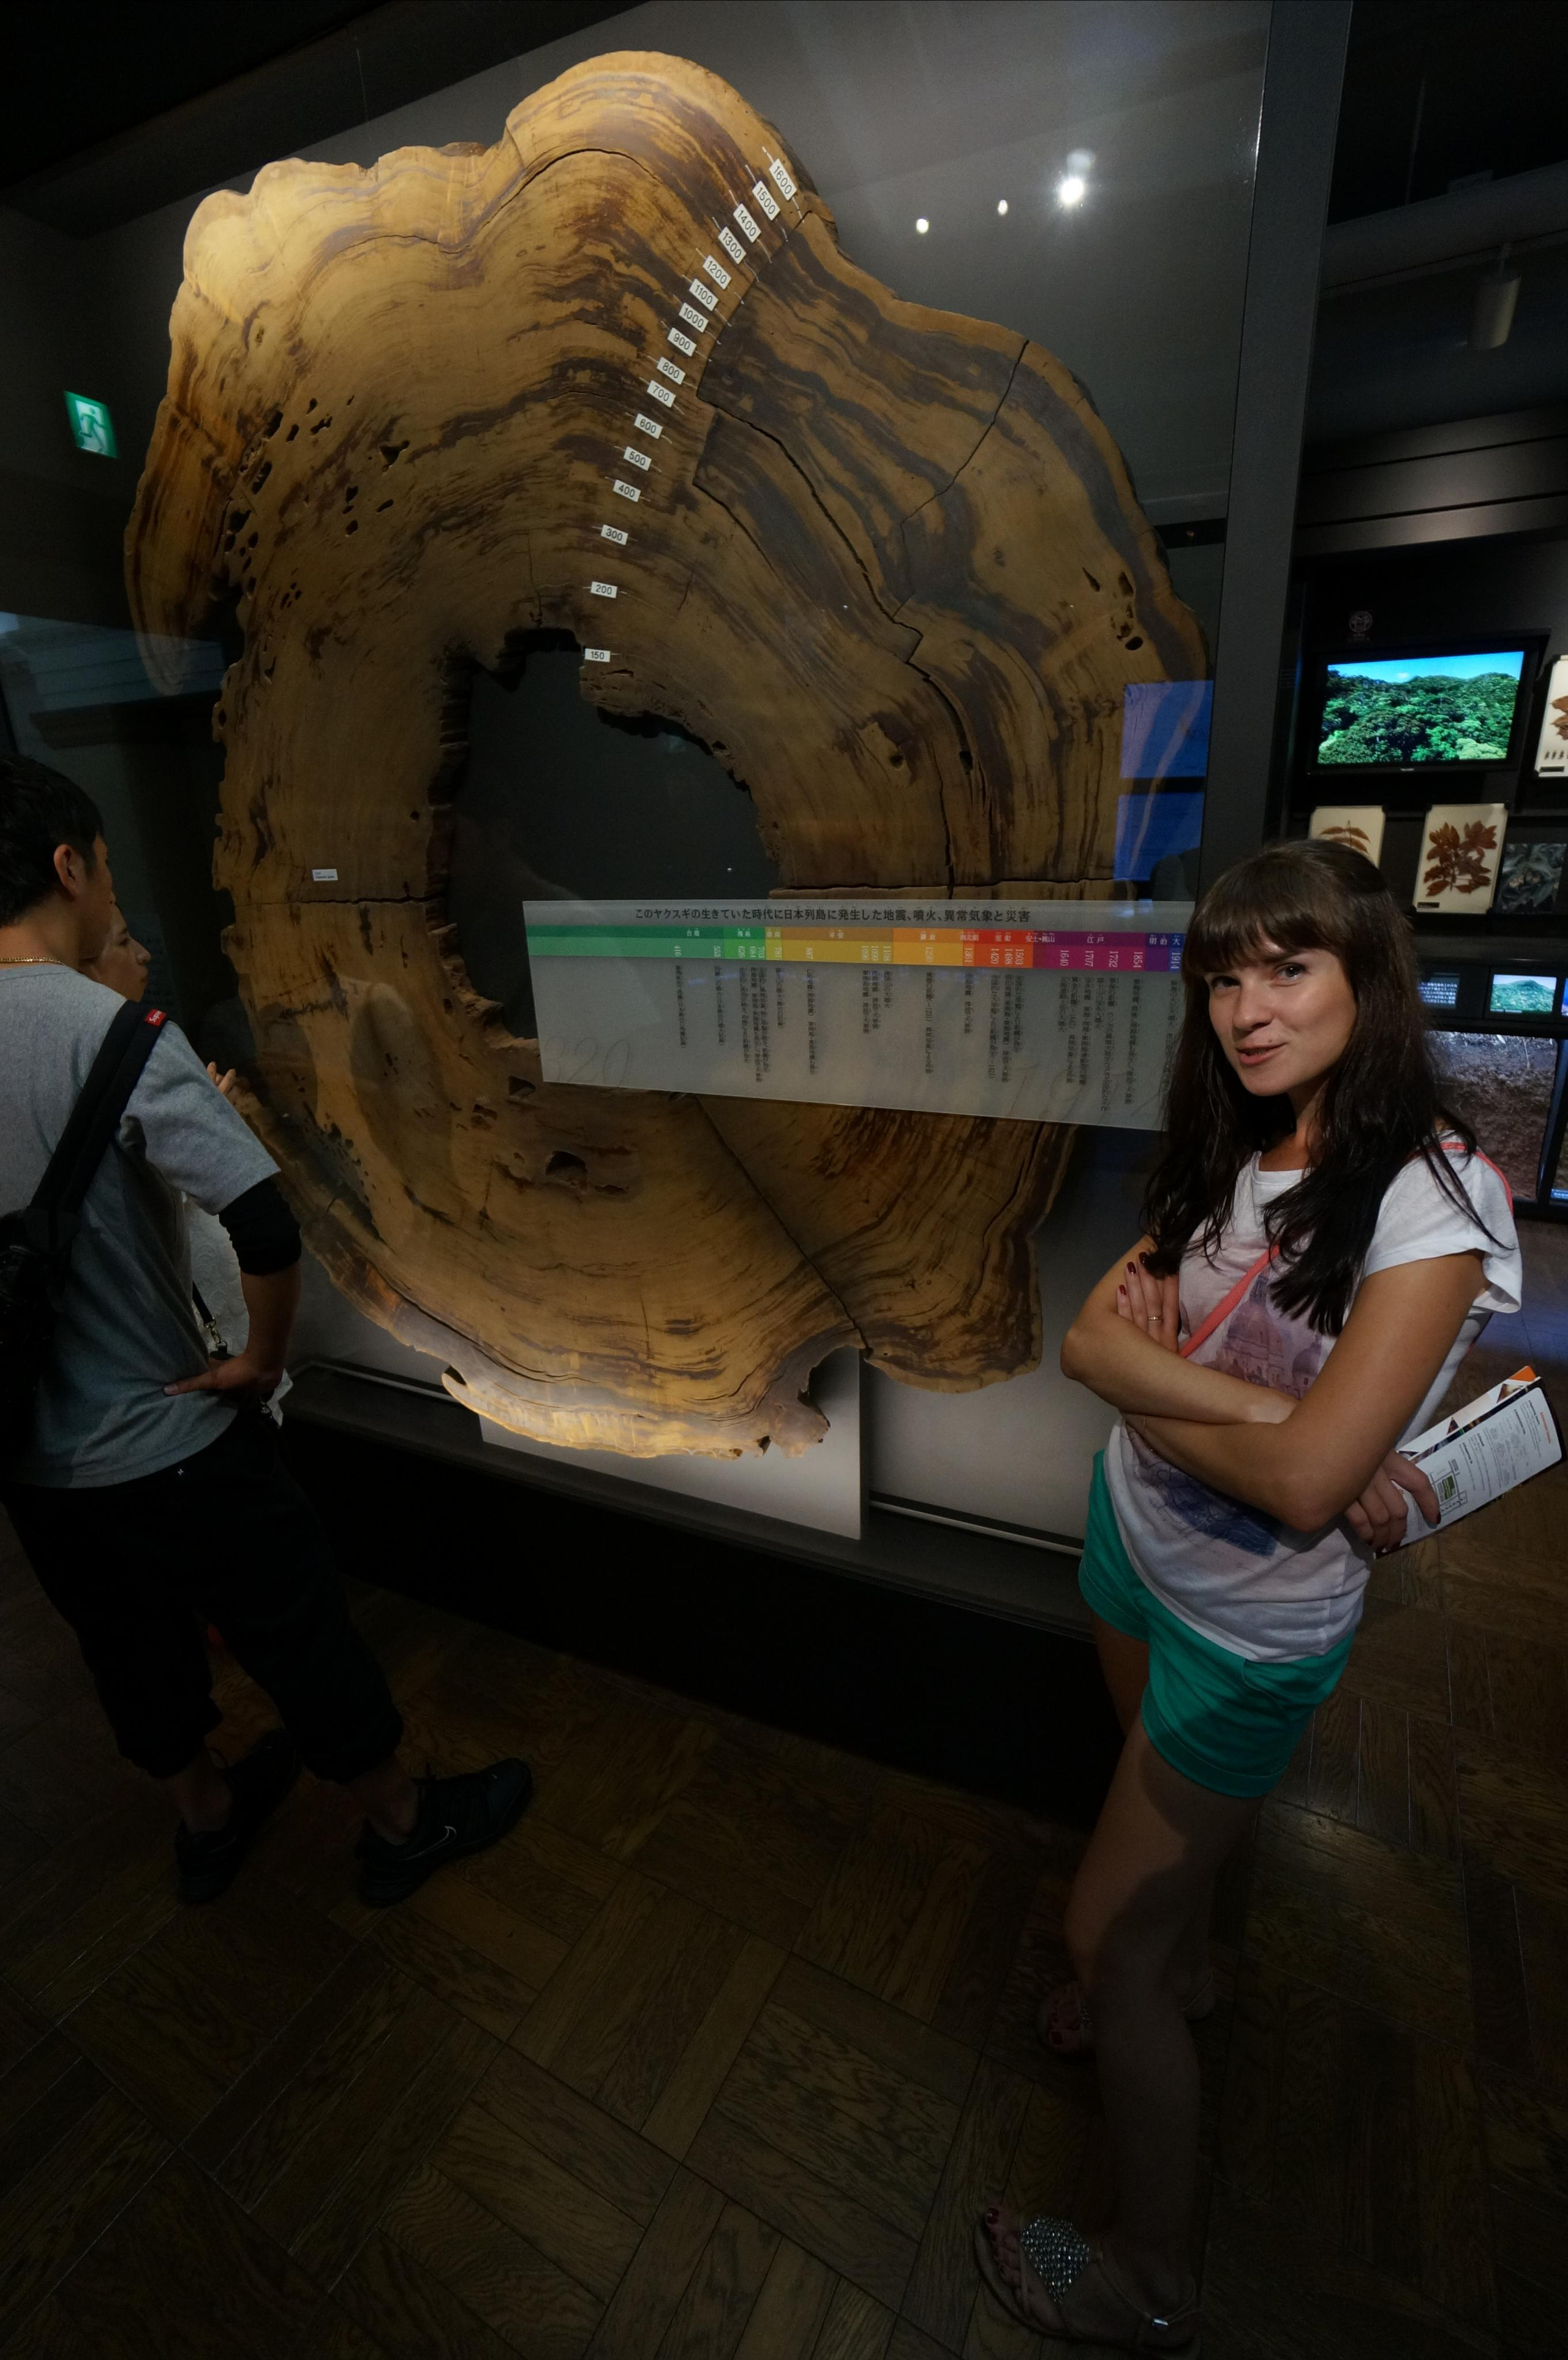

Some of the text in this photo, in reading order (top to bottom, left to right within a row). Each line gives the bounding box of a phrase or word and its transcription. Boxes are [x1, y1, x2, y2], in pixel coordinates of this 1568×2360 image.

[773, 165, 792, 194] 1600
[756, 186, 775, 214] 1500
[736, 210, 757, 237] 1400
[721, 233, 742, 259] 1300
[706, 261, 726, 284] 1200
[694, 284, 713, 304] 1100
[683, 308, 704, 328] 1000
[673, 333, 691, 350] 900
[662, 361, 680, 379] 800
[652, 385, 670, 402] 700
[639, 419, 657, 433] 600
[628, 451, 646, 466] 500
[618, 484, 635, 497] 400
[606, 529, 623, 542] 300
[595, 584, 612, 596] 200
[590, 651, 605, 660] 150
[1087, 936, 1105, 944] 江戸
[1149, 937, 1167, 945] 明治
[1085, 950, 1095, 967] 1707
[1108, 950, 1118, 967] 1732
[1133, 951, 1143, 968] 1854
[1170, 951, 1181, 969] 1914
